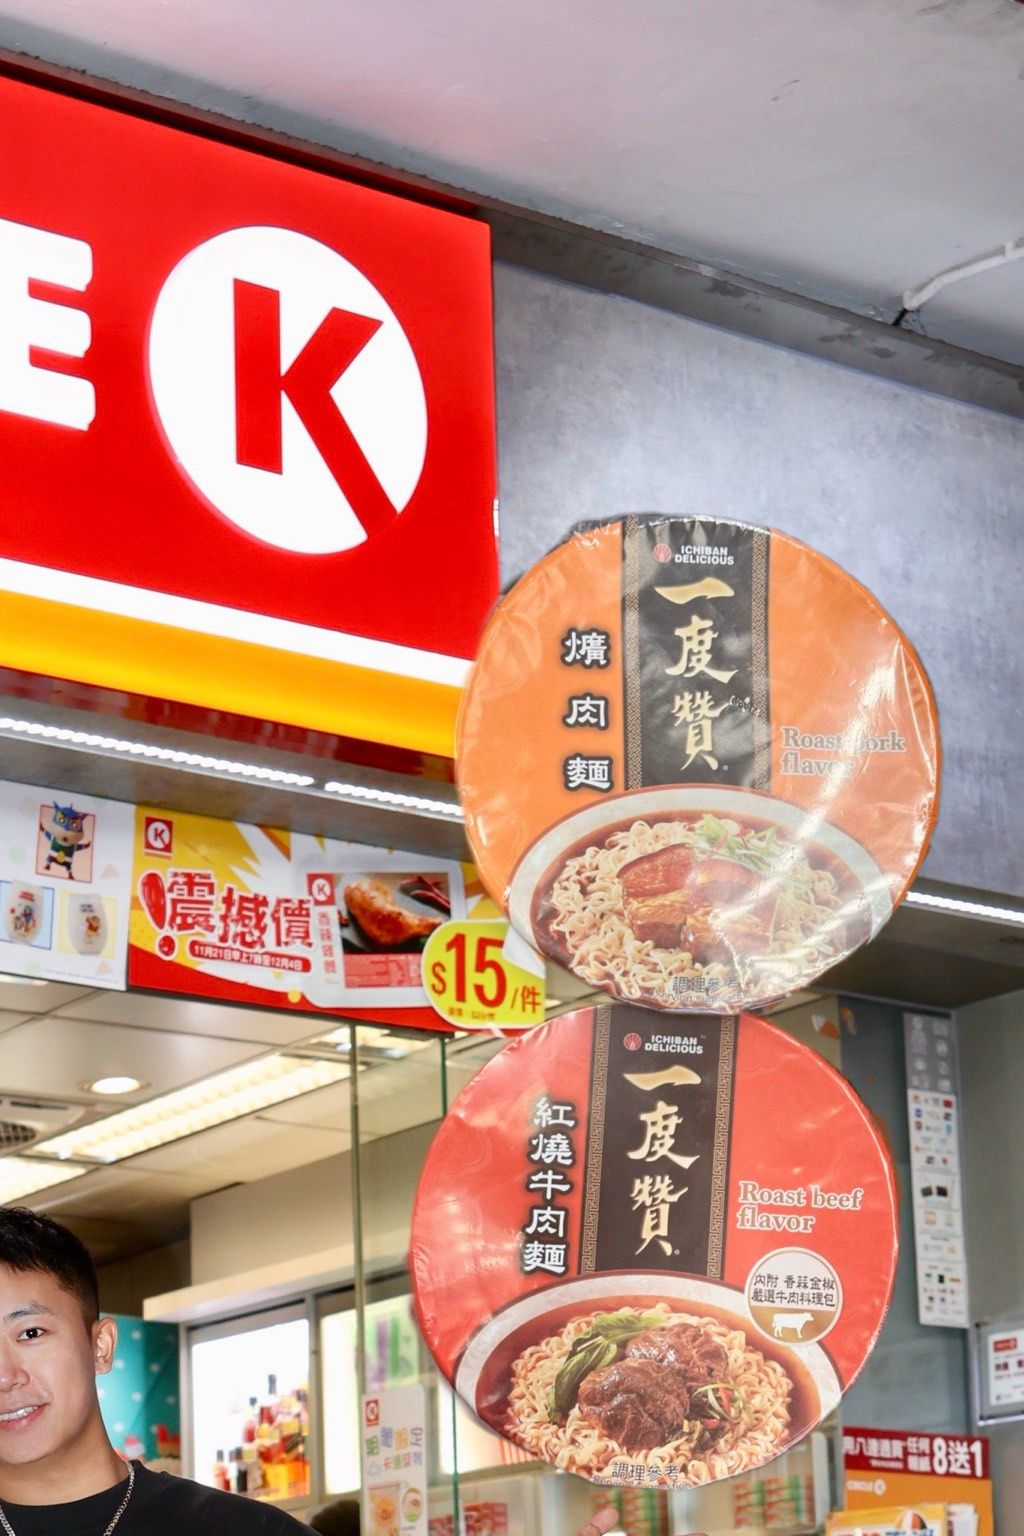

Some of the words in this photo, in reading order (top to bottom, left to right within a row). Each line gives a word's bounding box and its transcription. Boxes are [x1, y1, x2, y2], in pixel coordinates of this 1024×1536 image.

[674, 554, 735, 566] DELICIOUS
[680, 545, 729, 557] ICHIBAN
[781, 726, 844, 751] Roast
[166, 870, 314, 950] 震撼價
[644, 1042, 704, 1055] DELICIOUS
[650, 1034, 698, 1046] ICHIBAN
[523, 1096, 575, 1275] 紅燒牛肉麵
[739, 1181, 806, 1206] Roast
[810, 1185, 864, 1210] beef
[736, 1205, 816, 1233] flavor
